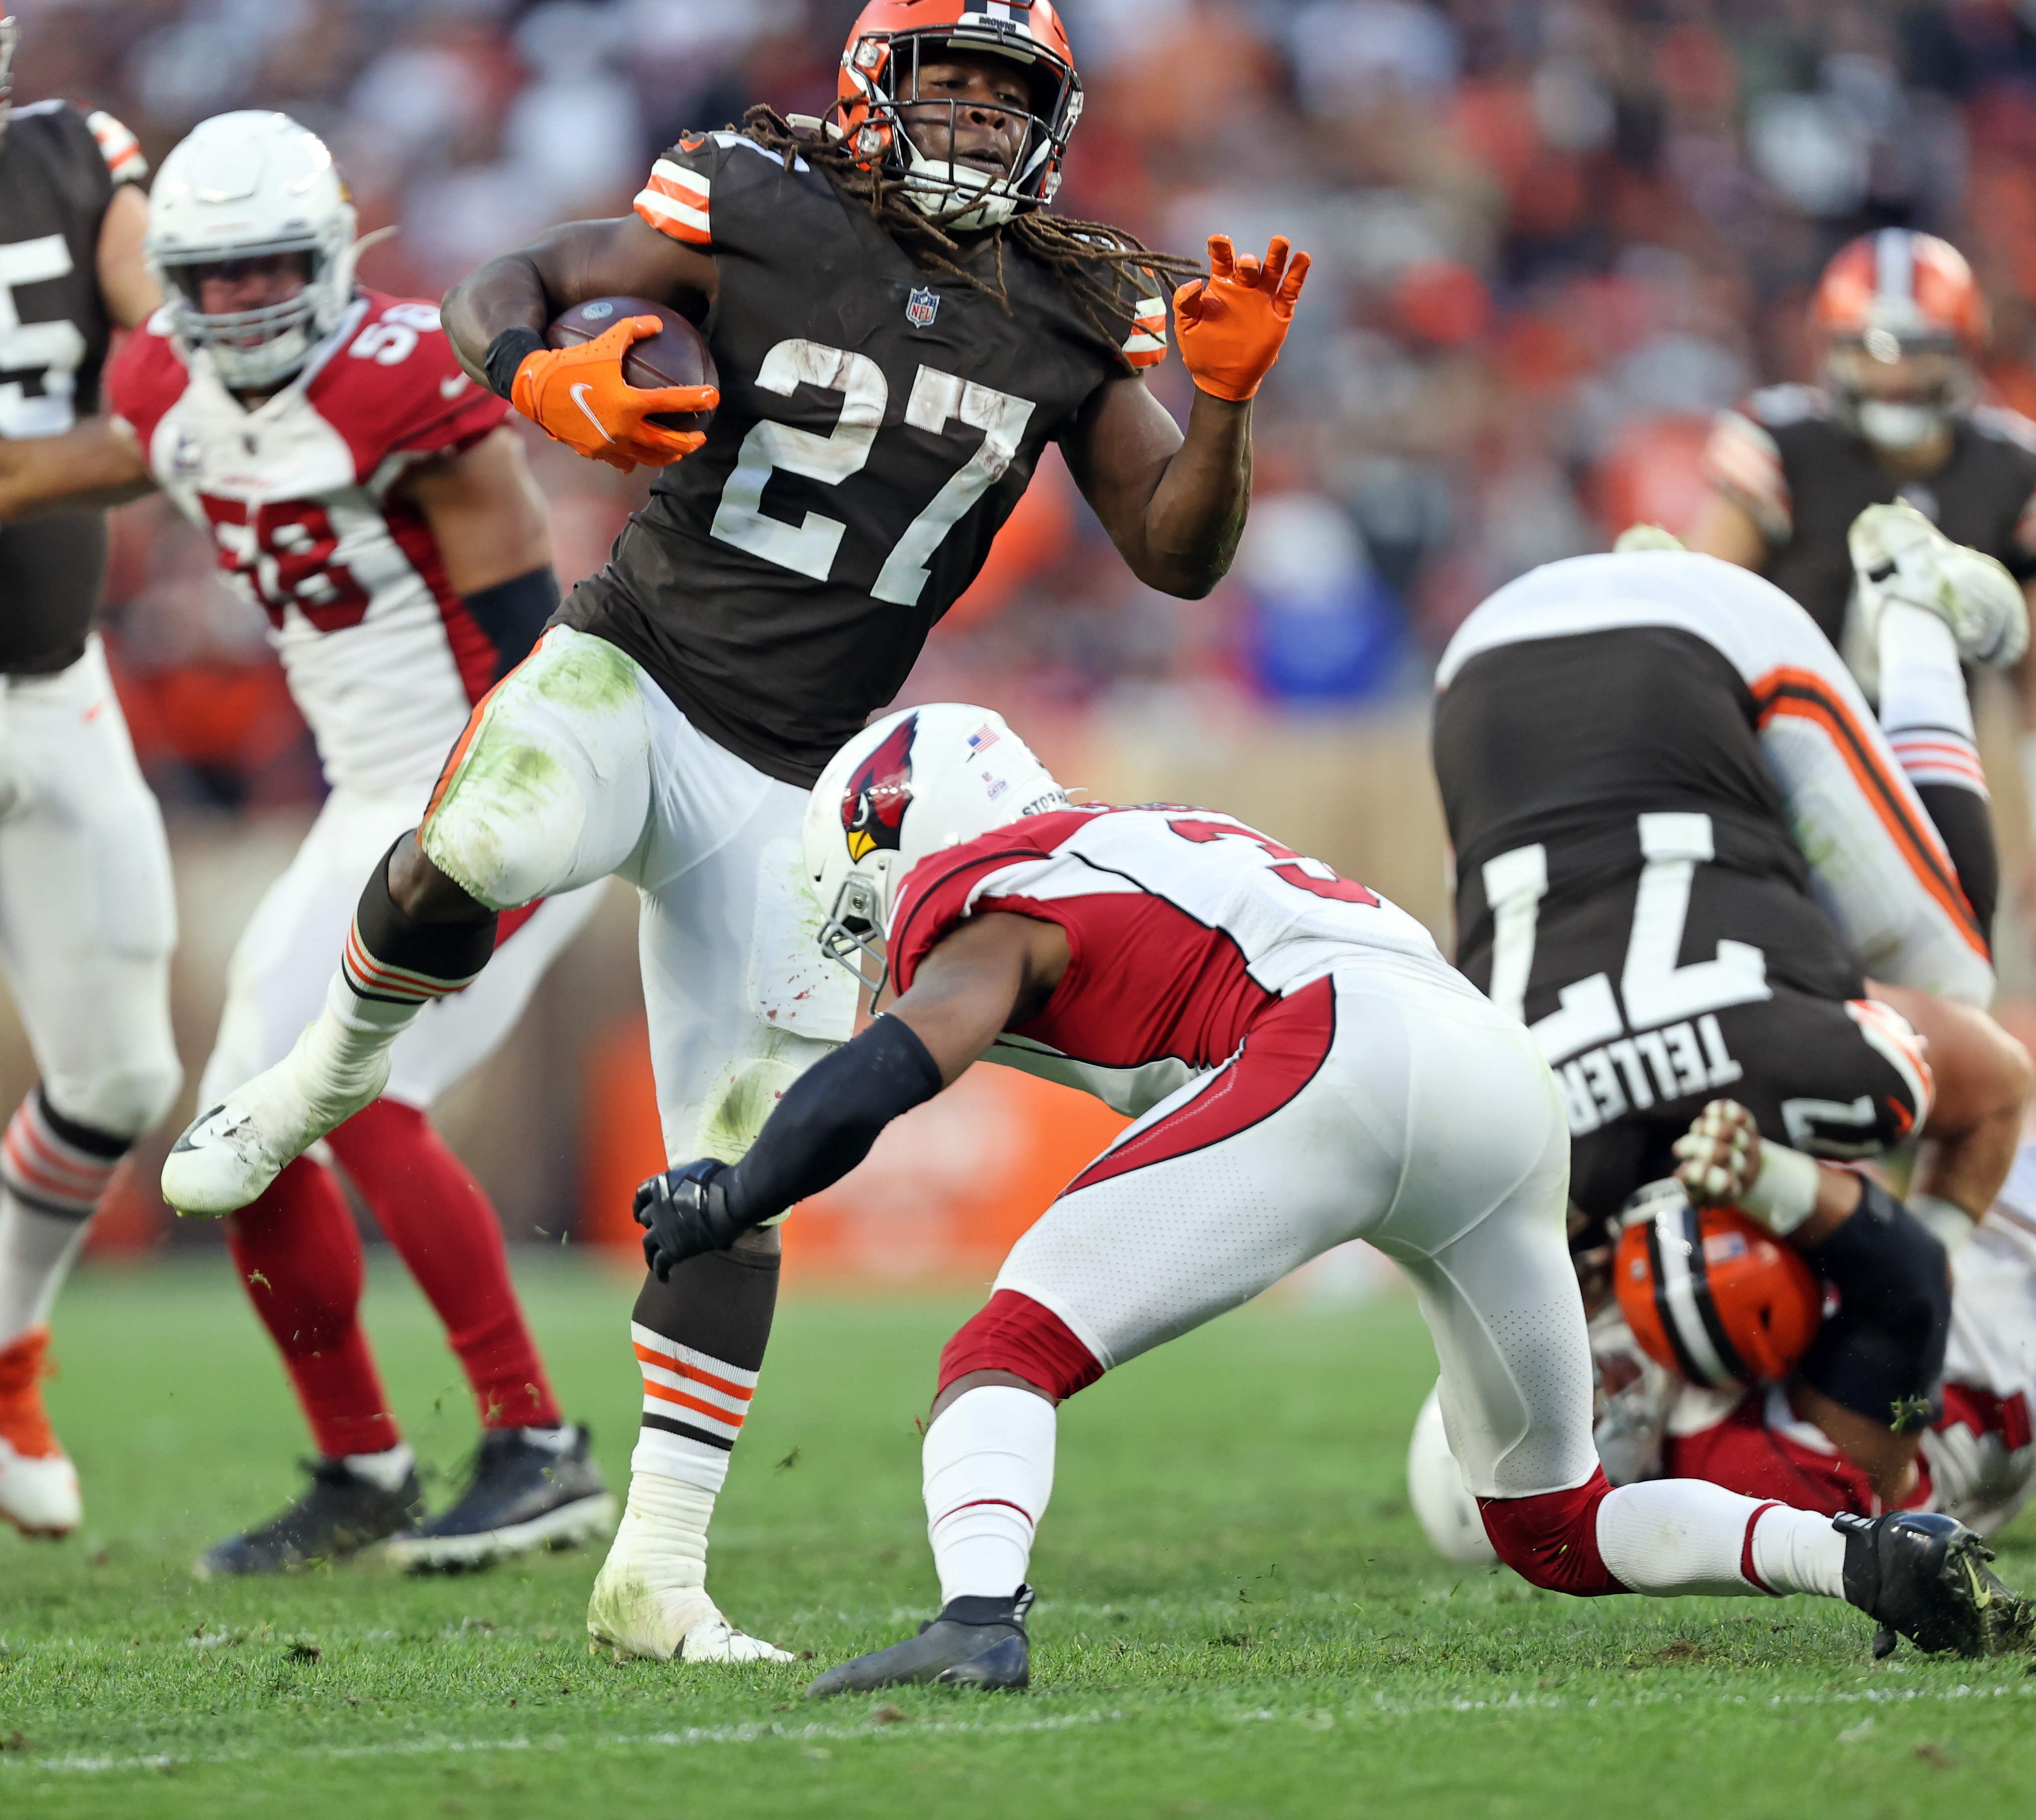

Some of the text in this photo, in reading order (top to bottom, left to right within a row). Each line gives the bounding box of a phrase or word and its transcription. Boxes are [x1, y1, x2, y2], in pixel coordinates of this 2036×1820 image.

[911, 304, 931, 321] NFL
[710, 338, 1036, 606] 27
[1553, 1013, 1745, 1138] TELLER
